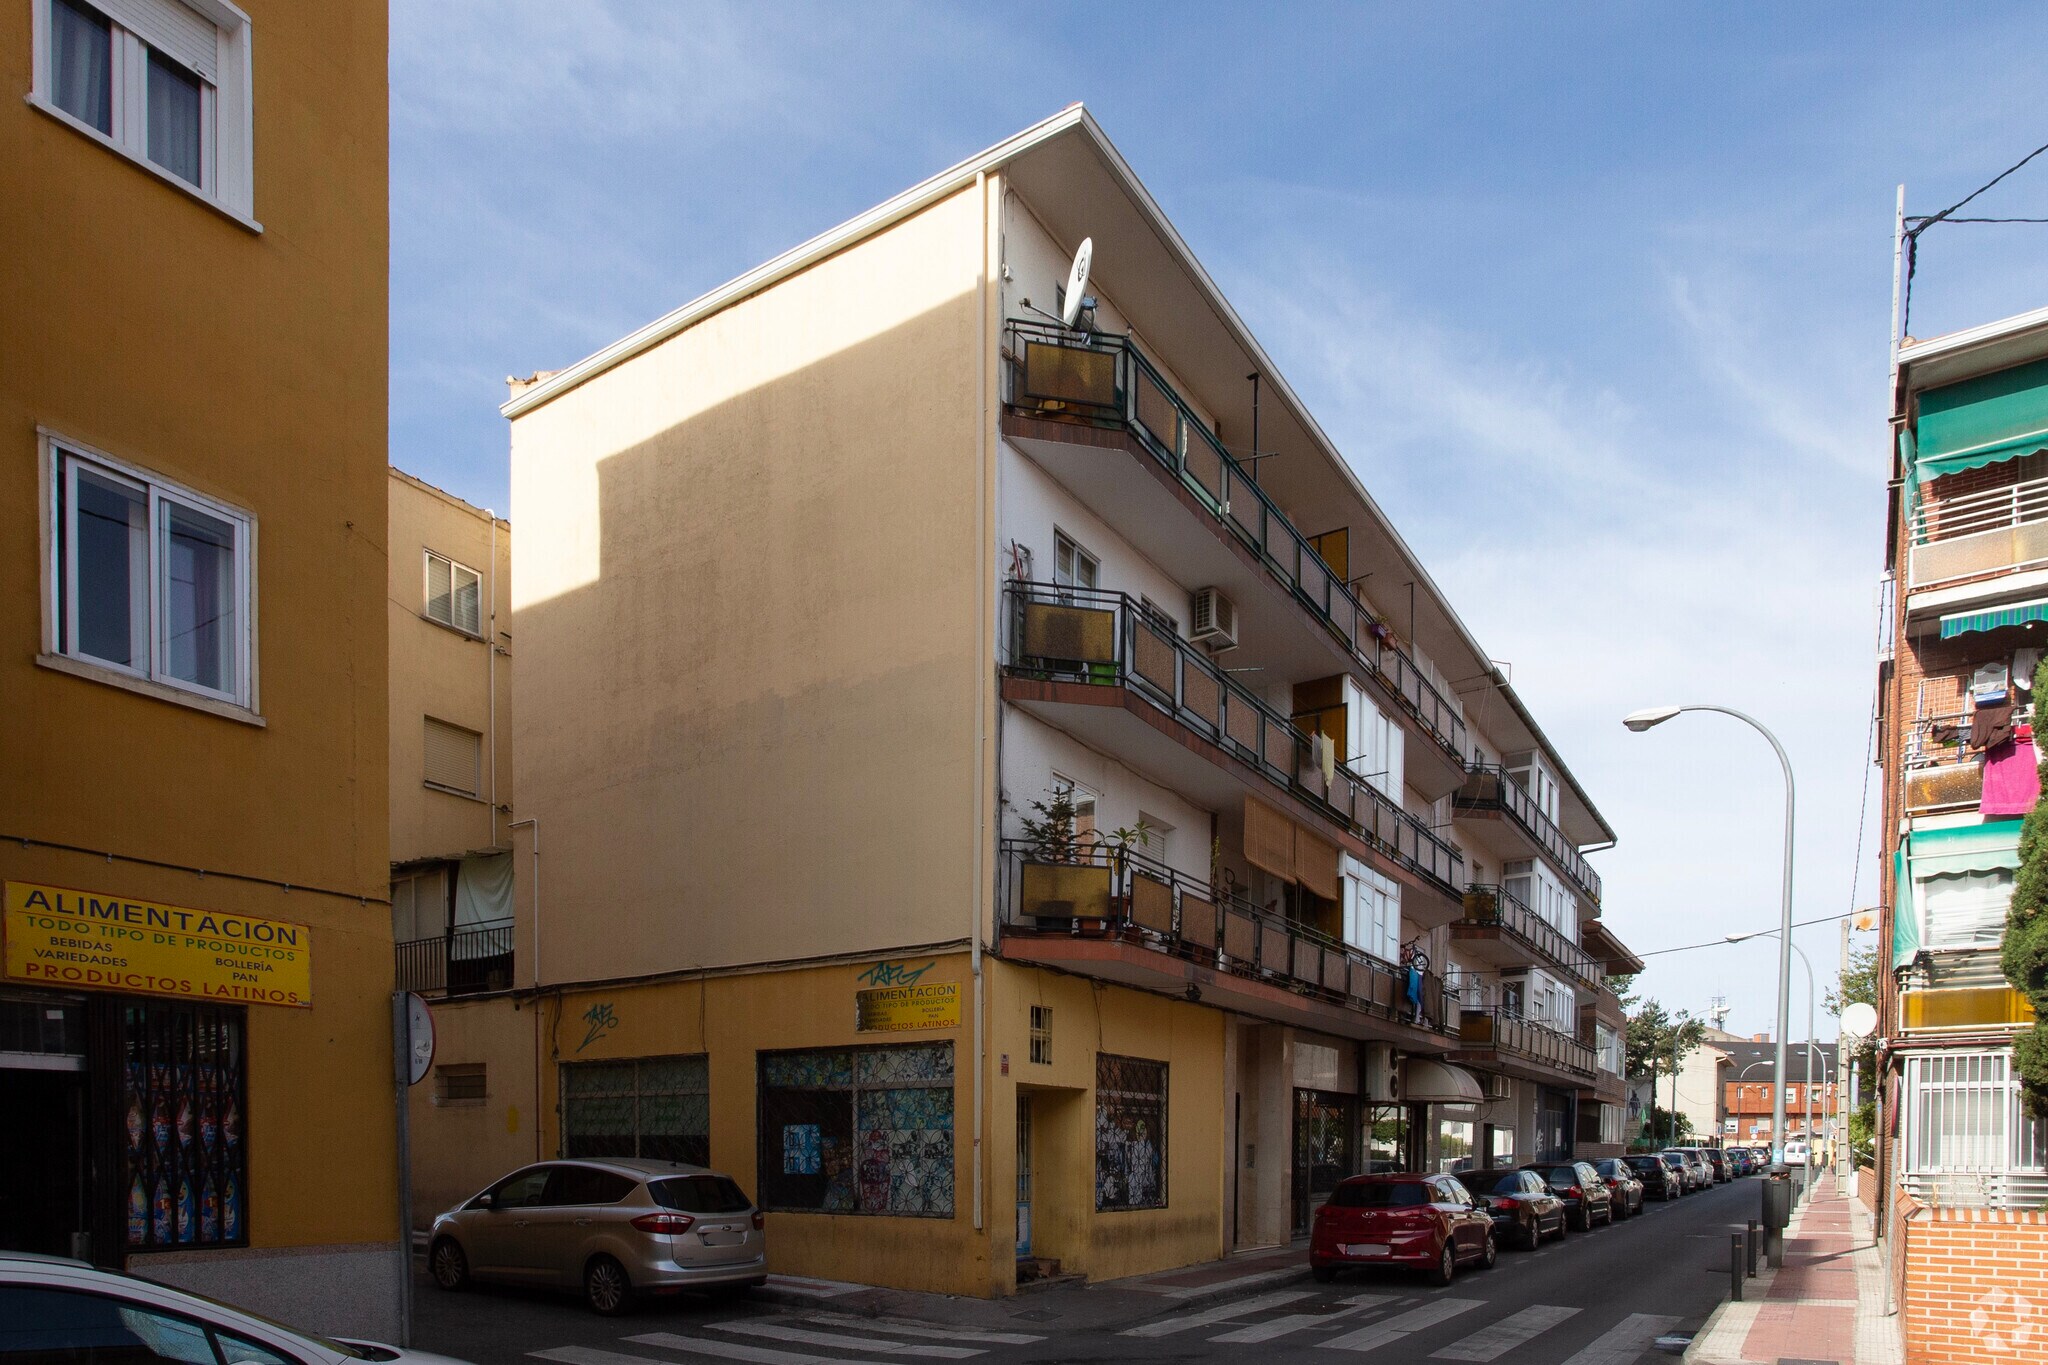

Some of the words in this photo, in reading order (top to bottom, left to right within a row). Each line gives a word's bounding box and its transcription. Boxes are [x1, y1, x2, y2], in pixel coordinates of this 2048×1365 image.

[25, 890, 297, 945] ALIMENTACIÓN
[27, 916, 90, 934] TODO
[101, 925, 144, 941] TIPO
[154, 933, 177, 946] DE
[186, 938, 295, 961] PRODUCTOS
[50, 936, 113, 952] BEBIDAS
[34, 948, 128, 967] VARIEDADES
[215, 957, 274, 972] BOLLERÍA
[26, 962, 192, 992] PRODUCTOS
[203, 982, 299, 1004] LATINOS
[233, 972, 258, 982] PAN
[912, 998, 955, 1007] PRODUCTOS
[918, 1019, 955, 1028] LATINOS
